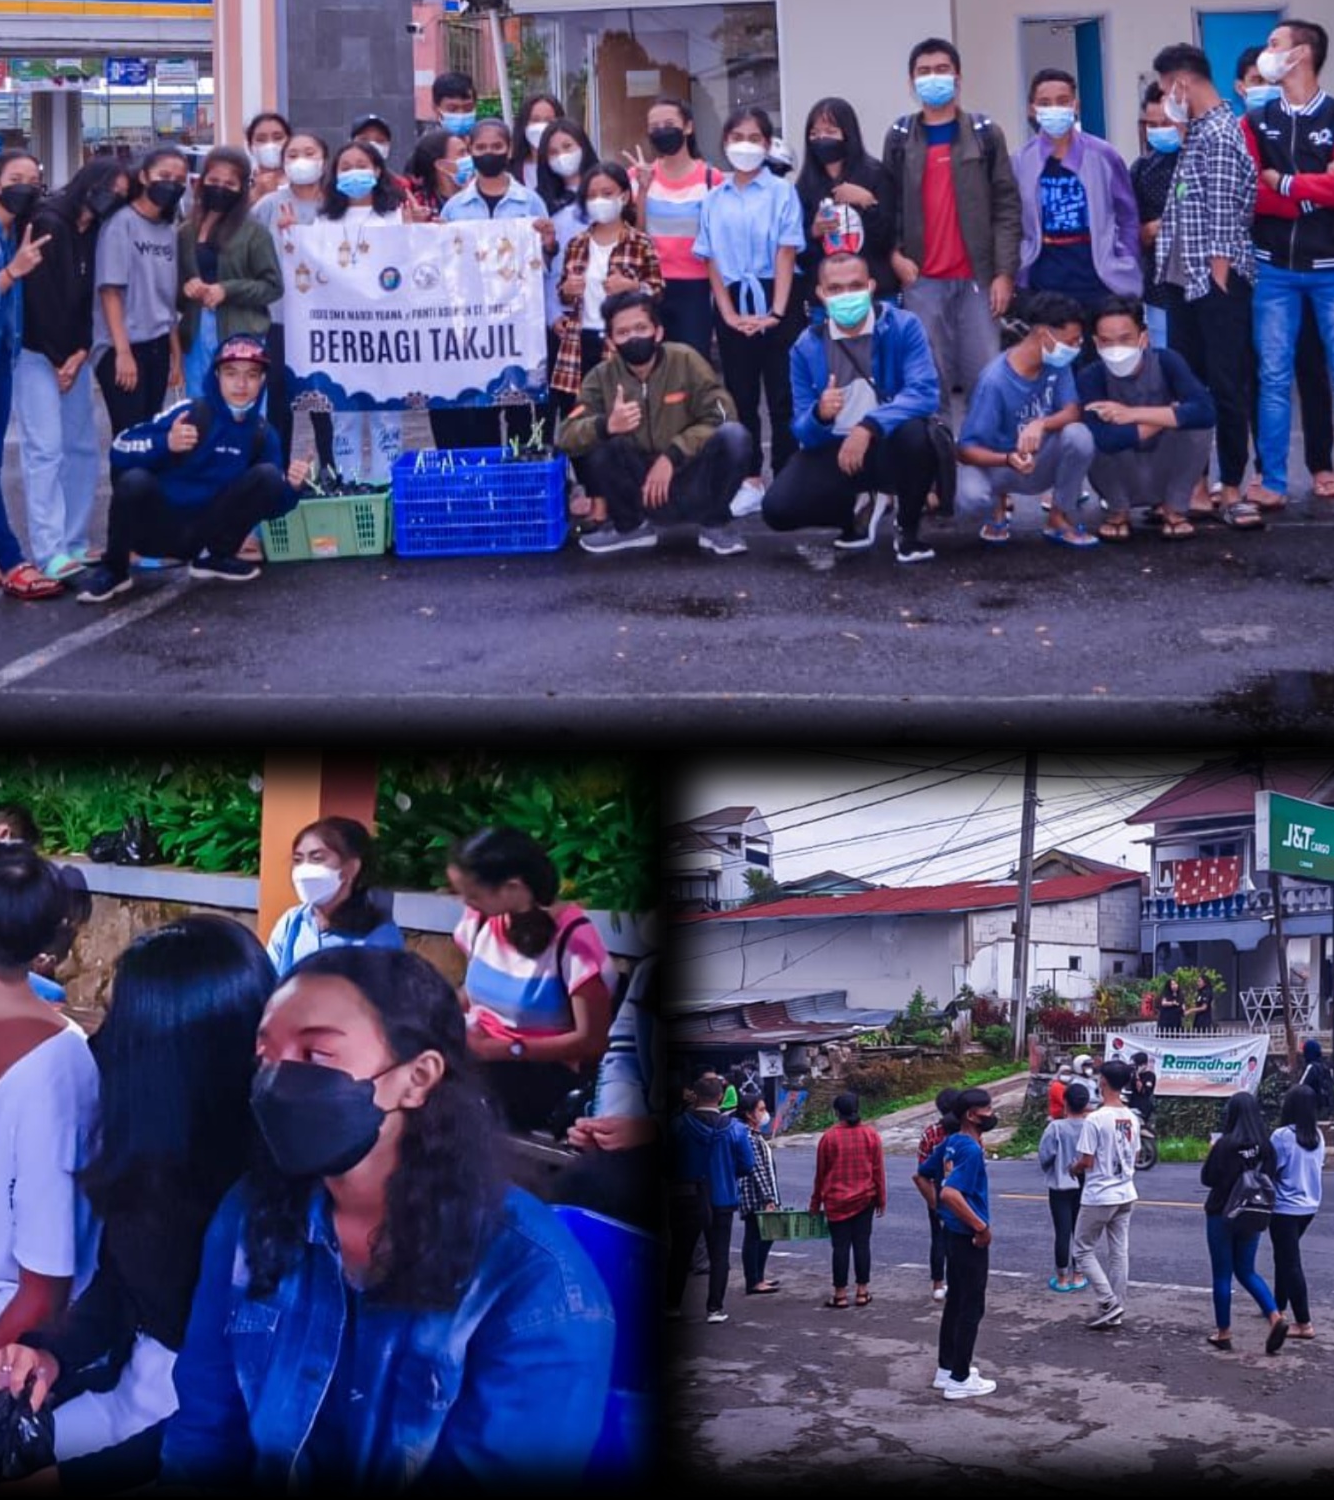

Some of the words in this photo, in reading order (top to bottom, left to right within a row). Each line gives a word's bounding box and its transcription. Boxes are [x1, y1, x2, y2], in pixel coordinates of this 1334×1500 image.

[309, 329, 421, 364] BERBAGI
[429, 324, 522, 362] TAKJIL
[1282, 823, 1316, 850] J&T
[1310, 841, 1330, 855] CARGO
[1161, 1054, 1242, 1072] Ramadhan
